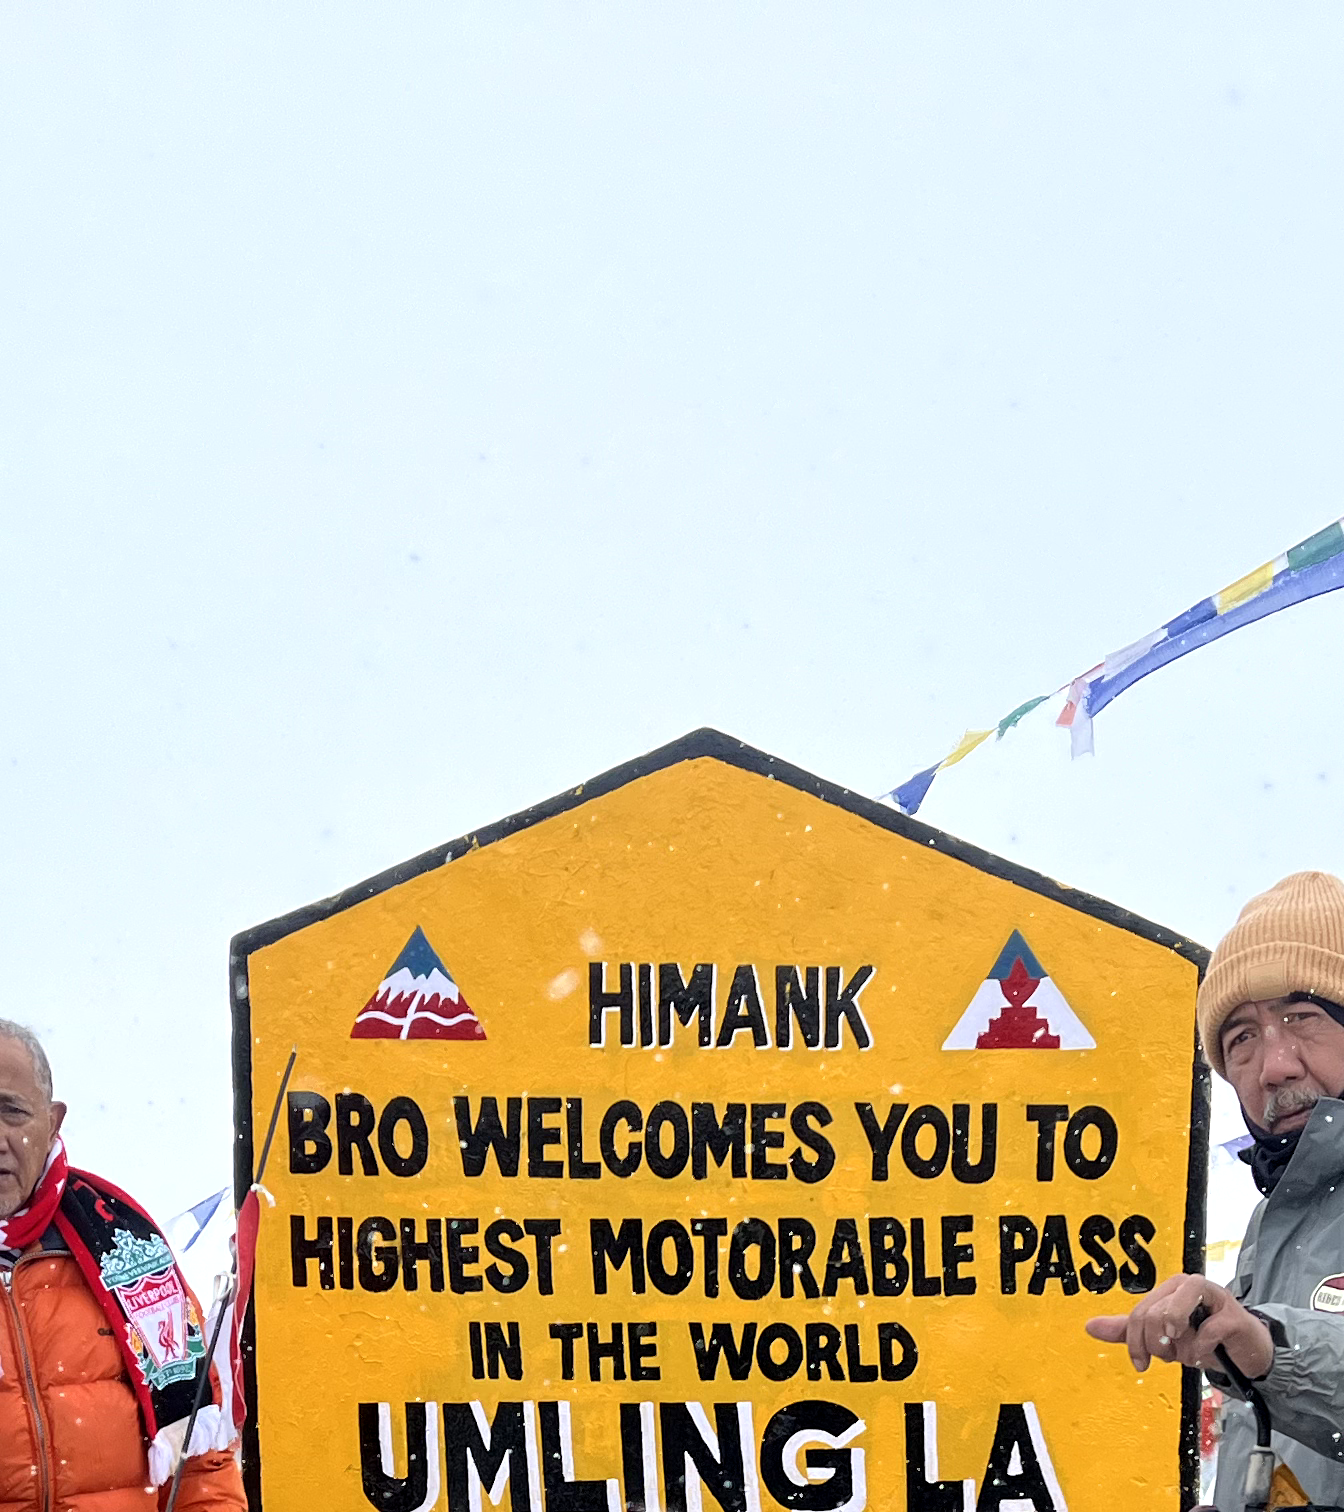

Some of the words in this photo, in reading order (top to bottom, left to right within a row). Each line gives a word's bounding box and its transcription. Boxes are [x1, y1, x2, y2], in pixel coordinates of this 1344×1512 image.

[590, 962, 876, 1050] HIMANK
[288, 1092, 428, 1177] BRO
[454, 1096, 835, 1183] WELCOMES
[855, 1103, 997, 1184] YOU
[1027, 1105, 1117, 1181] TO
[127, 1280, 179, 1311] LIVERPOOL
[291, 1216, 561, 1295] HIGHEST
[590, 1215, 976, 1300] MOTORABLE
[999, 1215, 1156, 1295] PASS
[470, 1322, 523, 1380] IN
[549, 1322, 660, 1381] THE
[689, 1322, 918, 1382] WORLD
